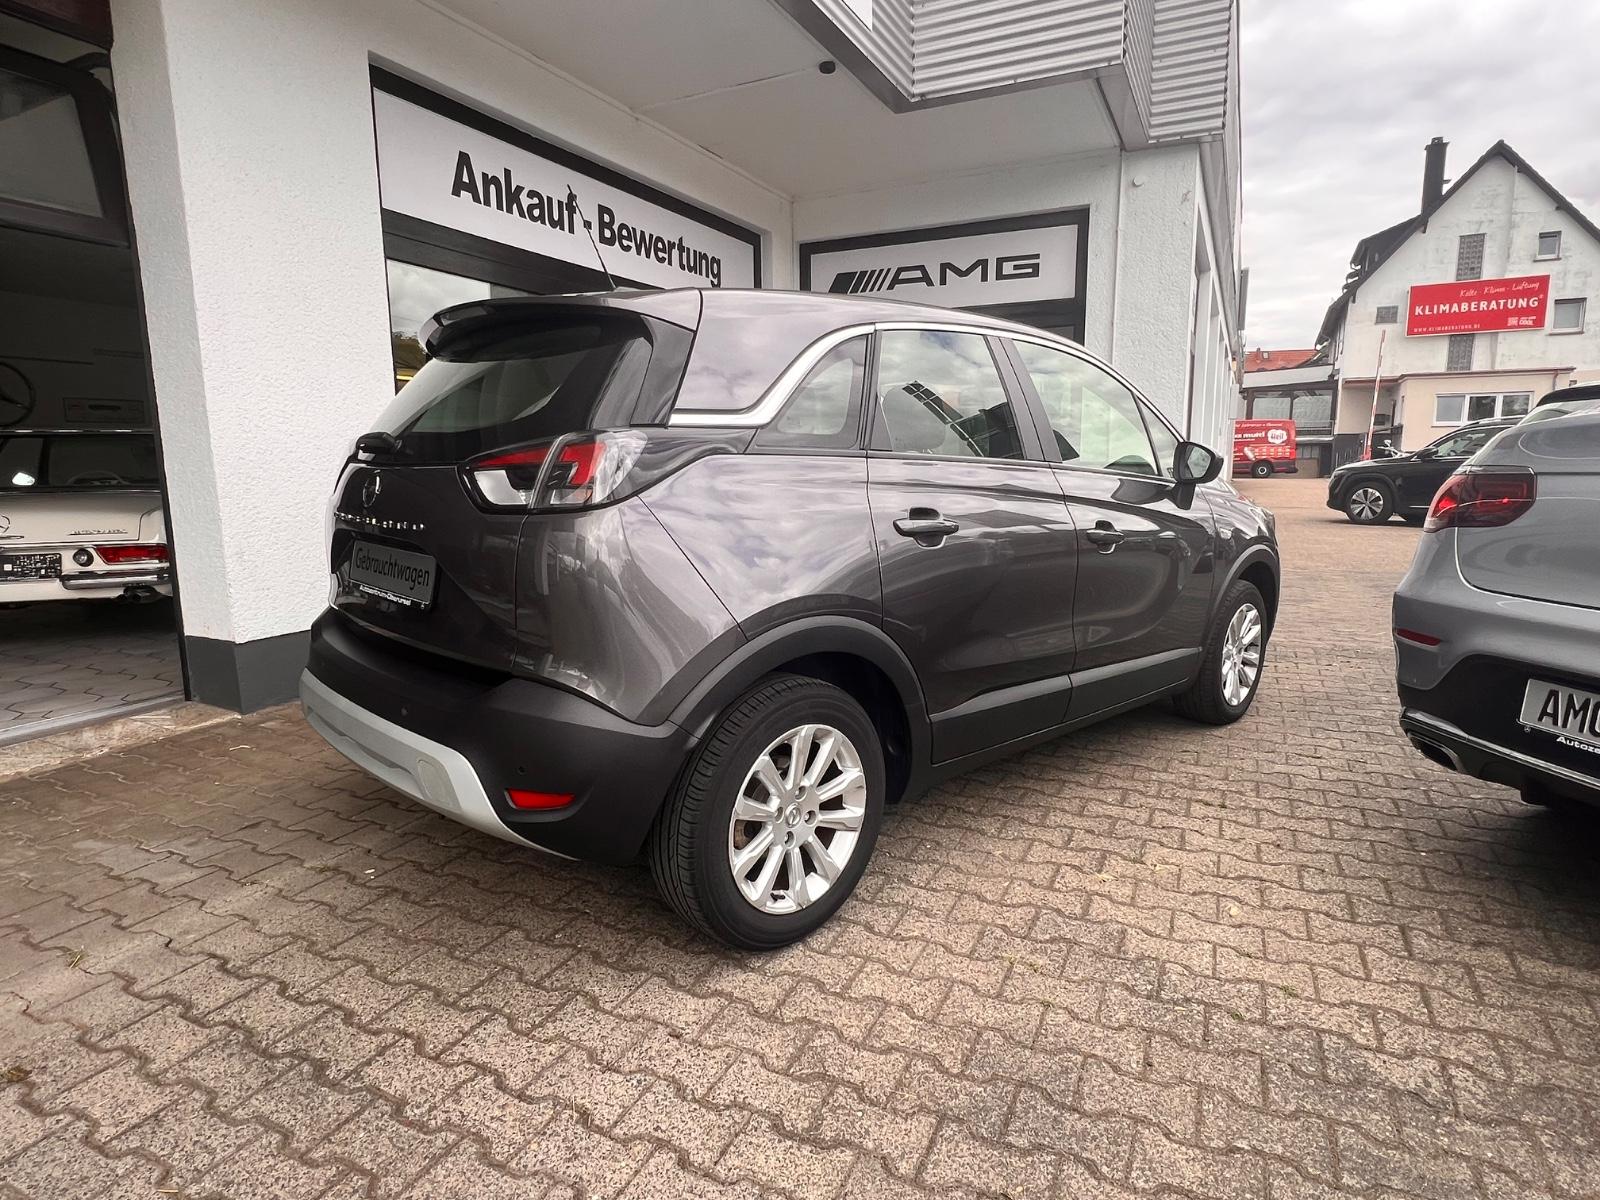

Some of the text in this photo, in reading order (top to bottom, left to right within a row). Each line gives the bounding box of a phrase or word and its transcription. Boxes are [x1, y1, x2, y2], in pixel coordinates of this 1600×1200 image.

[450, 150, 577, 235] Ankauf
[597, 203, 721, 288] Bewertung
[886, 253, 1041, 291] AMG
[355, 548, 430, 591] Gebrauchtwagen
